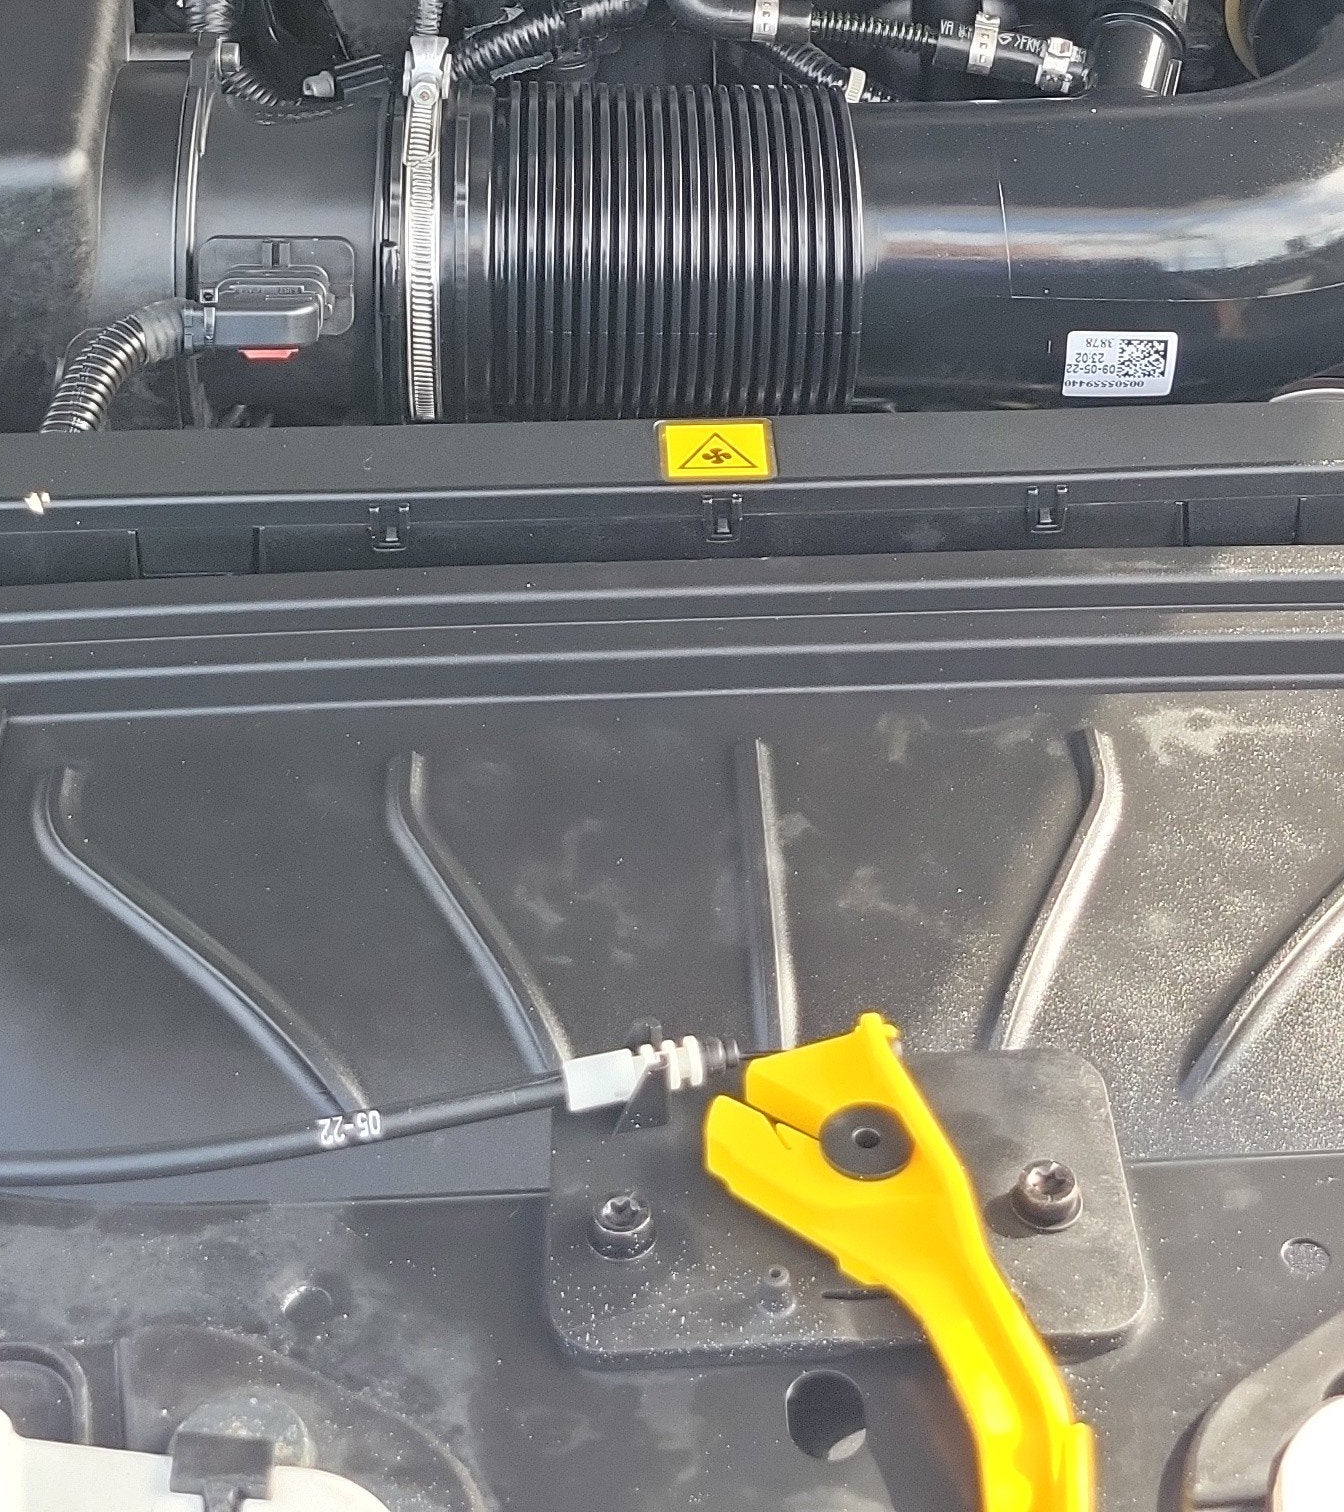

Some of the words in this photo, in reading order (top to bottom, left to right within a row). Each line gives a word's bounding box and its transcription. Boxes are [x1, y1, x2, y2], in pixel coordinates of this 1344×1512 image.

[1086, 339, 1114, 348] 3878
[1076, 353, 1105, 363] 23:02
[1066, 364, 1116, 375] 09-05-22
[317, 1109, 381, 1146] 05-22
